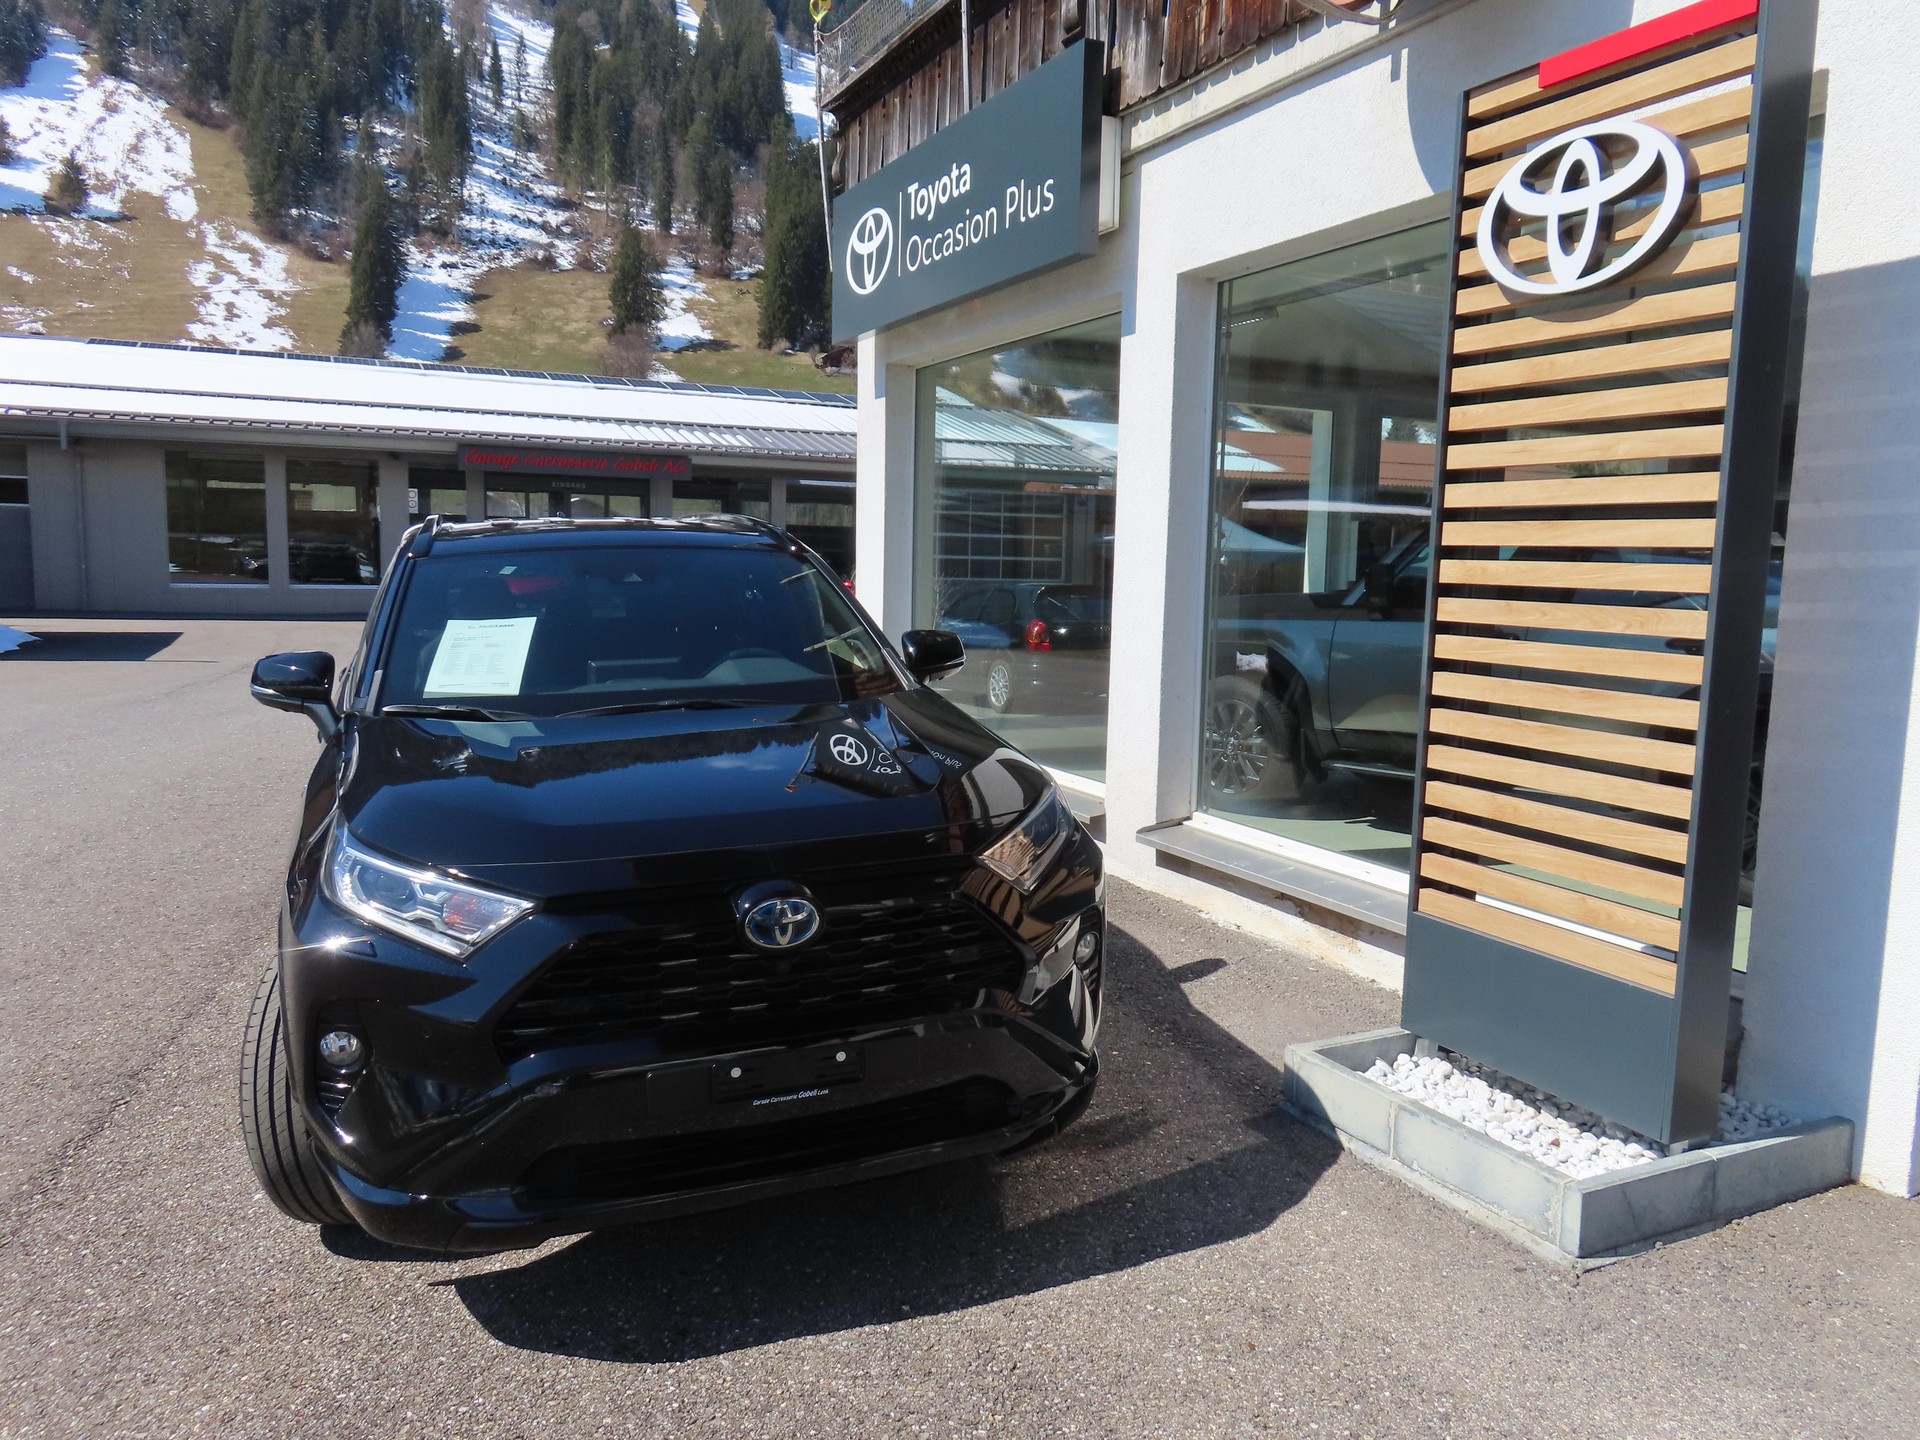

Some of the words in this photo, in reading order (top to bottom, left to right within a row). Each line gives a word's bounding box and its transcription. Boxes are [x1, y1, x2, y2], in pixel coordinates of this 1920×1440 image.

[907, 162, 971, 221] Toyota
[906, 206, 997, 272] Occasion
[1005, 178, 1055, 229] Plus
[465, 448, 519, 470] Garage
[525, 453, 608, 469] Carrosserie
[662, 461, 687, 474] AG
